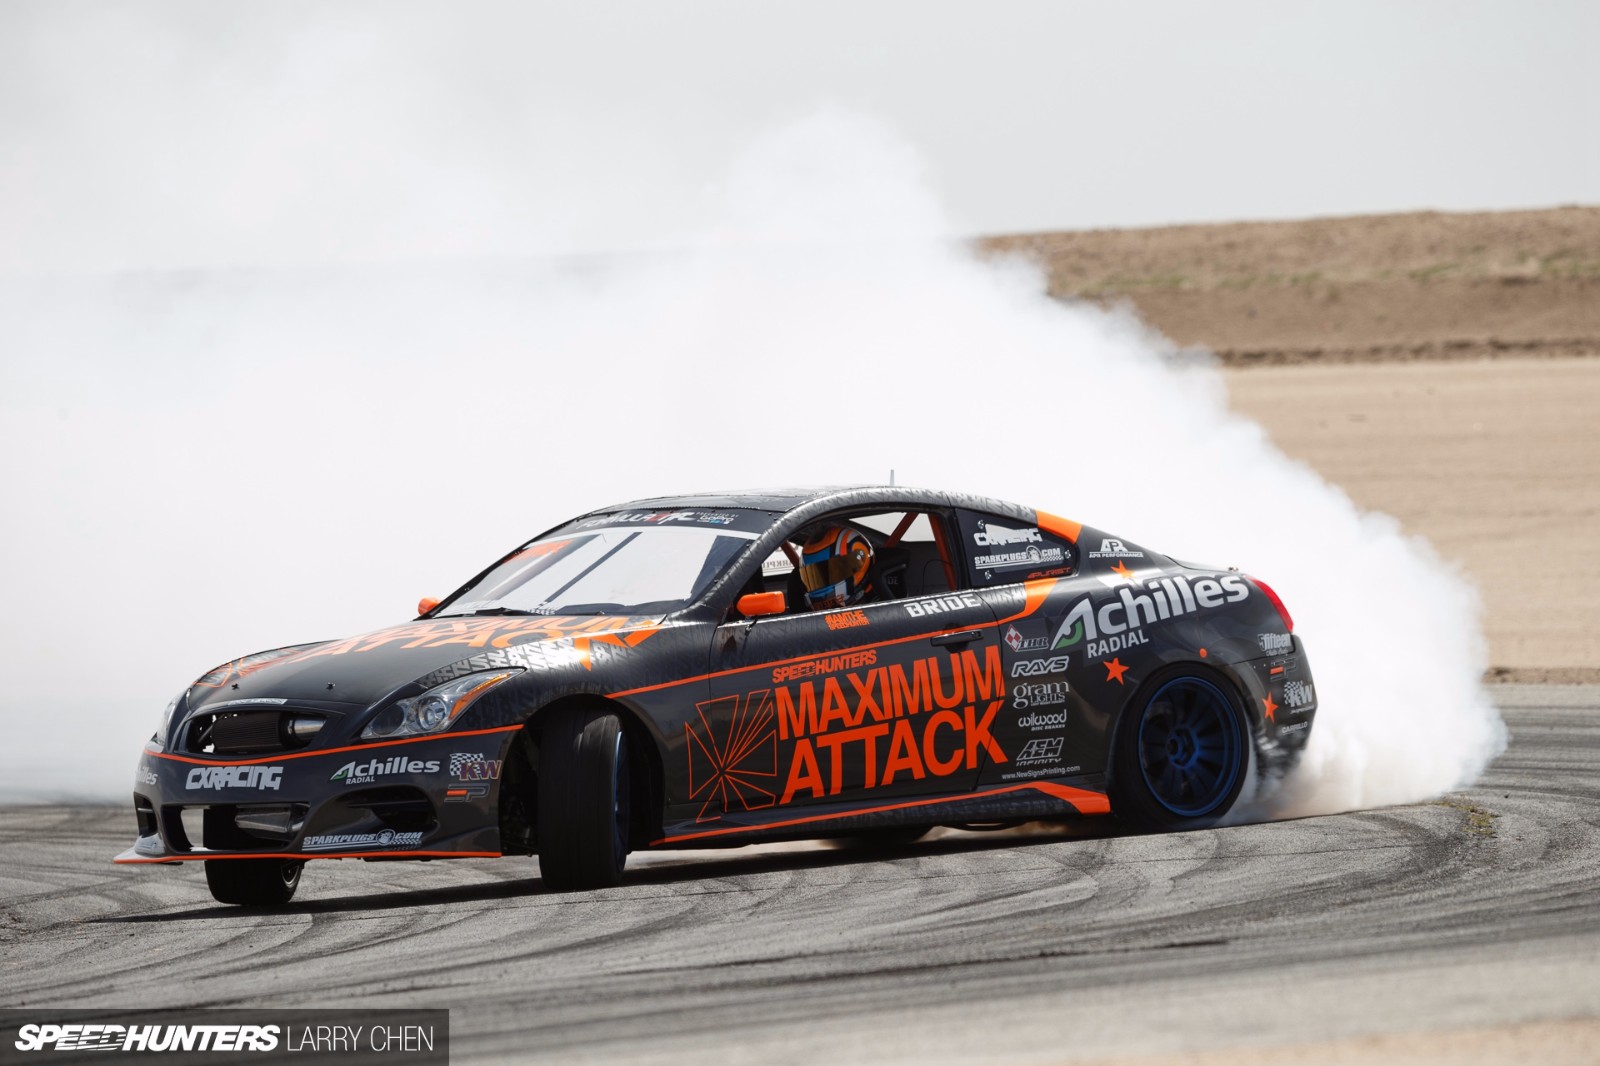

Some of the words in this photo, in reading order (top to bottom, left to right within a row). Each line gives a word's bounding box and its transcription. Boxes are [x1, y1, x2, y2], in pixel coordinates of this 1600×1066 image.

[974, 551, 1027, 565] SPARKPLUGS
[904, 594, 981, 618] BRIDE
[1050, 575, 1249, 650] Achilles
[1087, 629, 1149, 659] RADIAL
[772, 649, 877, 684] SPEEDHUNTERS
[1011, 655, 1070, 678] RAYS
[774, 644, 1006, 741] MAXIMUM
[1013, 681, 1070, 709] gram
[1018, 709, 1067, 728] wilwood
[779, 699, 1009, 805] ATTACK
[1016, 737, 1065, 761] AEM
[185, 766, 284, 791] CXRACING
[329, 756, 441, 781] Achilles
[345, 775, 376, 785] RADIAL
[459, 759, 503, 781] KW
[1001, 765, 1081, 780] www.NewSignsPrinting.com
[302, 833, 377, 846] SPARKPLUGS
